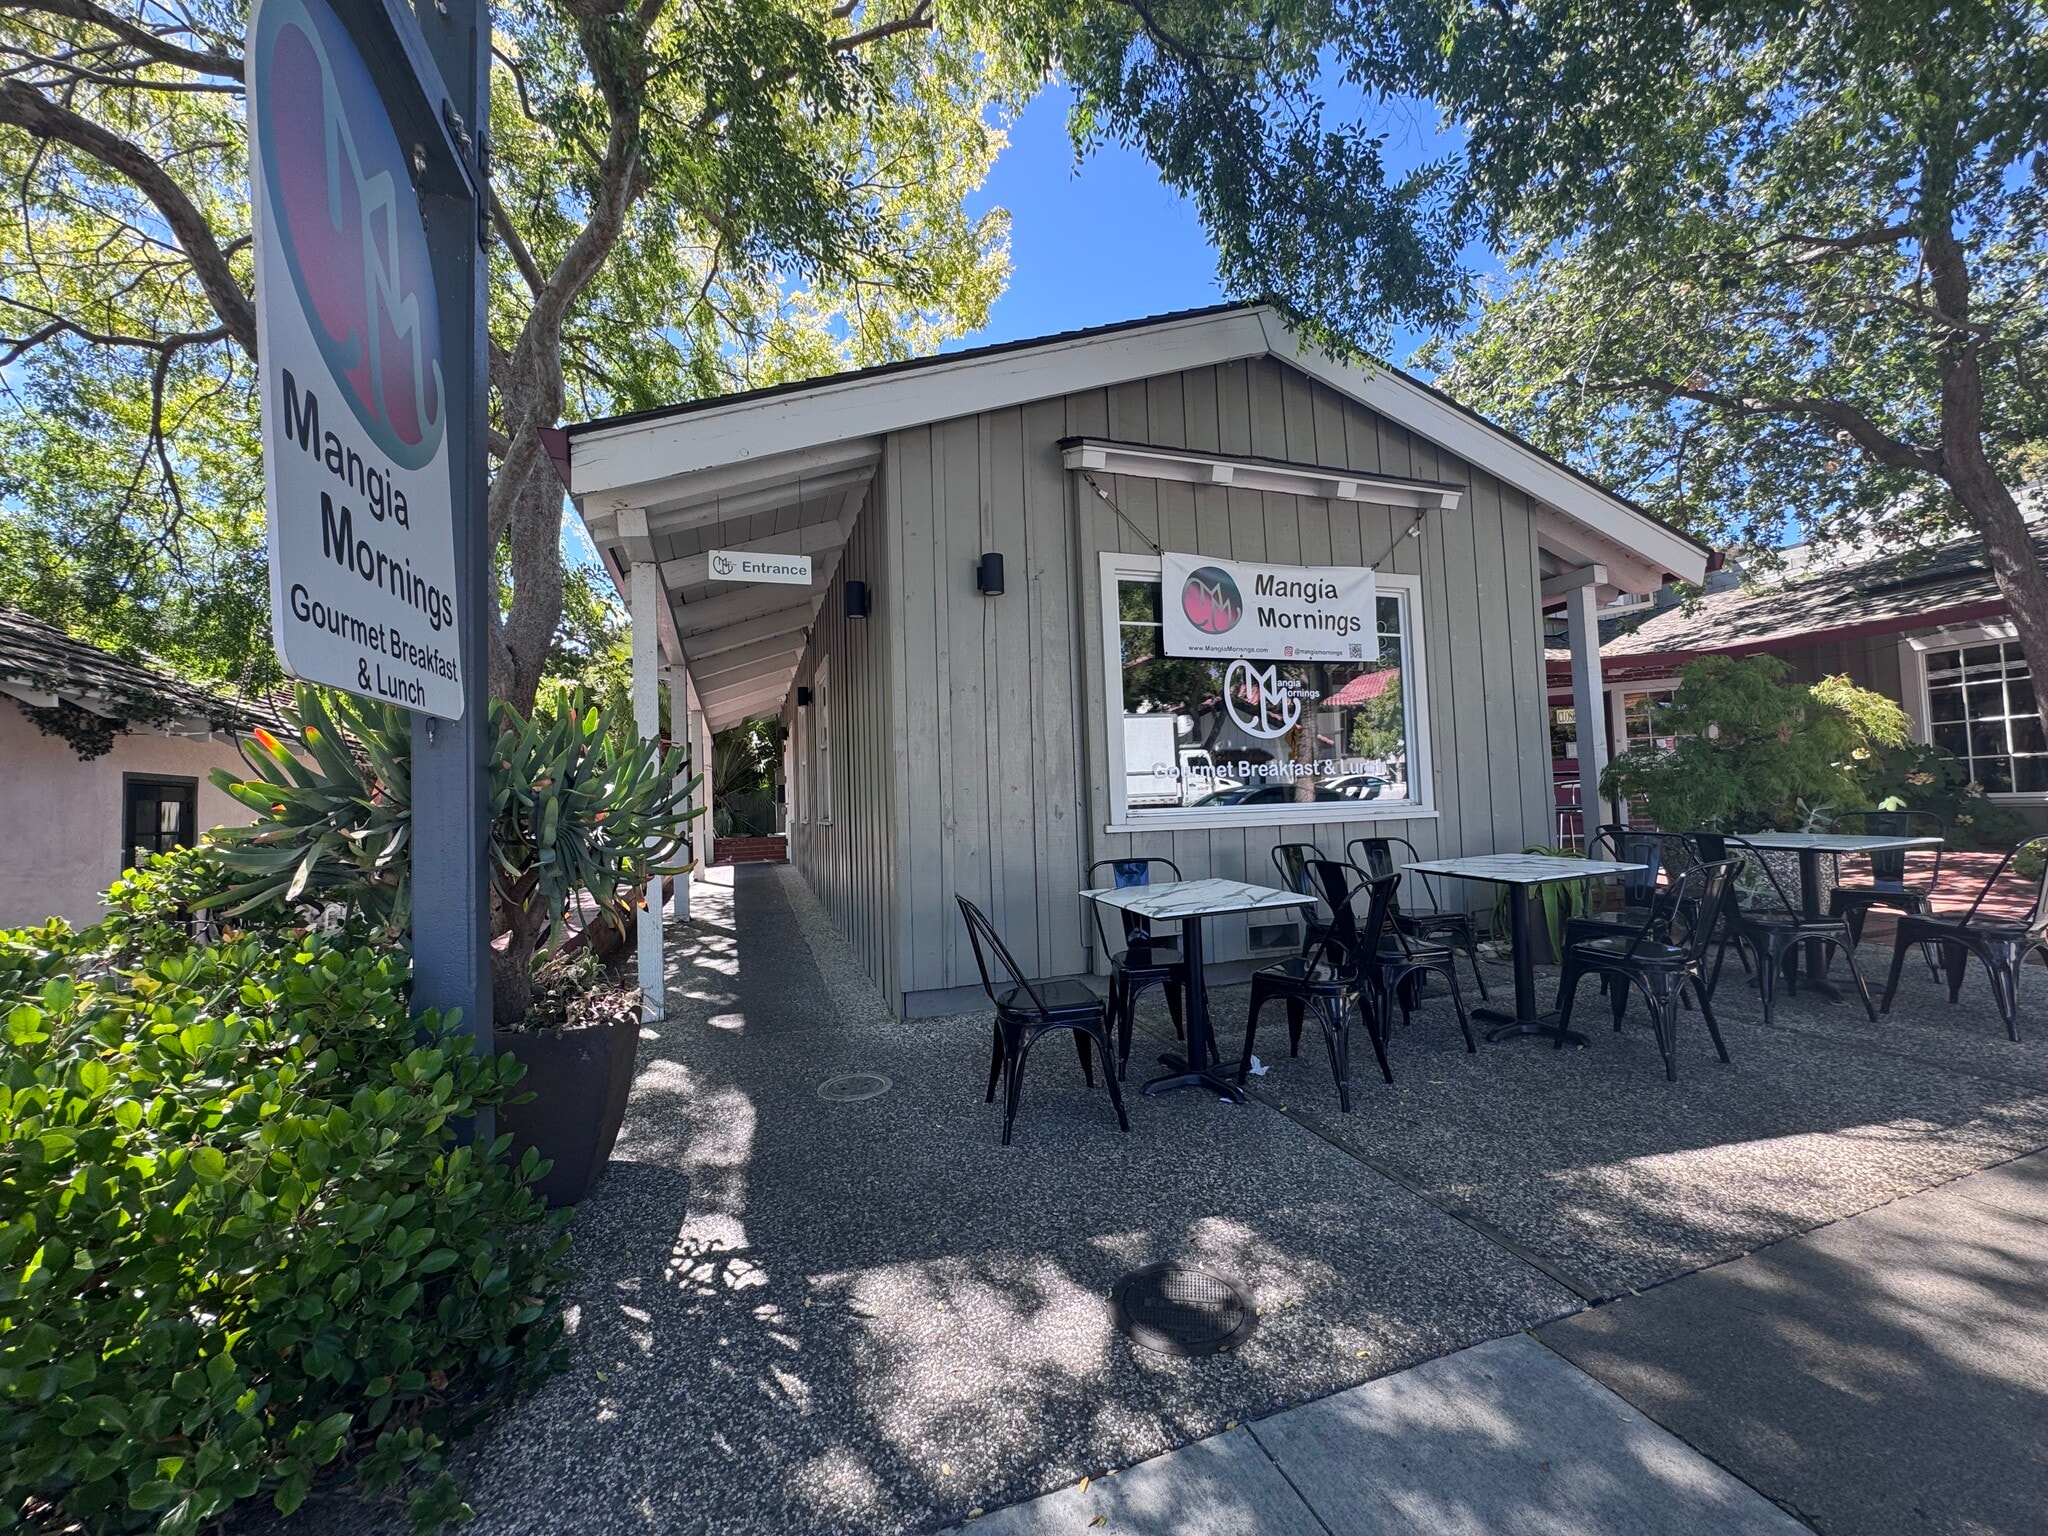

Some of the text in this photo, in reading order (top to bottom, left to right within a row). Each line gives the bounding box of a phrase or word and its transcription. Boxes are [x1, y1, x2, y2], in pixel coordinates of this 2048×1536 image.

[282, 367, 410, 531] Mangia
[320, 490, 453, 632] Mornings
[742, 561, 807, 576] Entrance
[1255, 573, 1338, 604] Mangia
[290, 583, 459, 684] Gourmet Breakfast
[1257, 606, 1361, 637] Mornings
[1188, 644, 1269, 654] www.MangiaMornings.com
[1294, 648, 1343, 657] @mangiamornings
[357, 657, 427, 707] & Lunch
[1152, 761, 1234, 779] Gourmet
[1238, 758, 1320, 778] Breakfast
[1323, 758, 1337, 776] &
